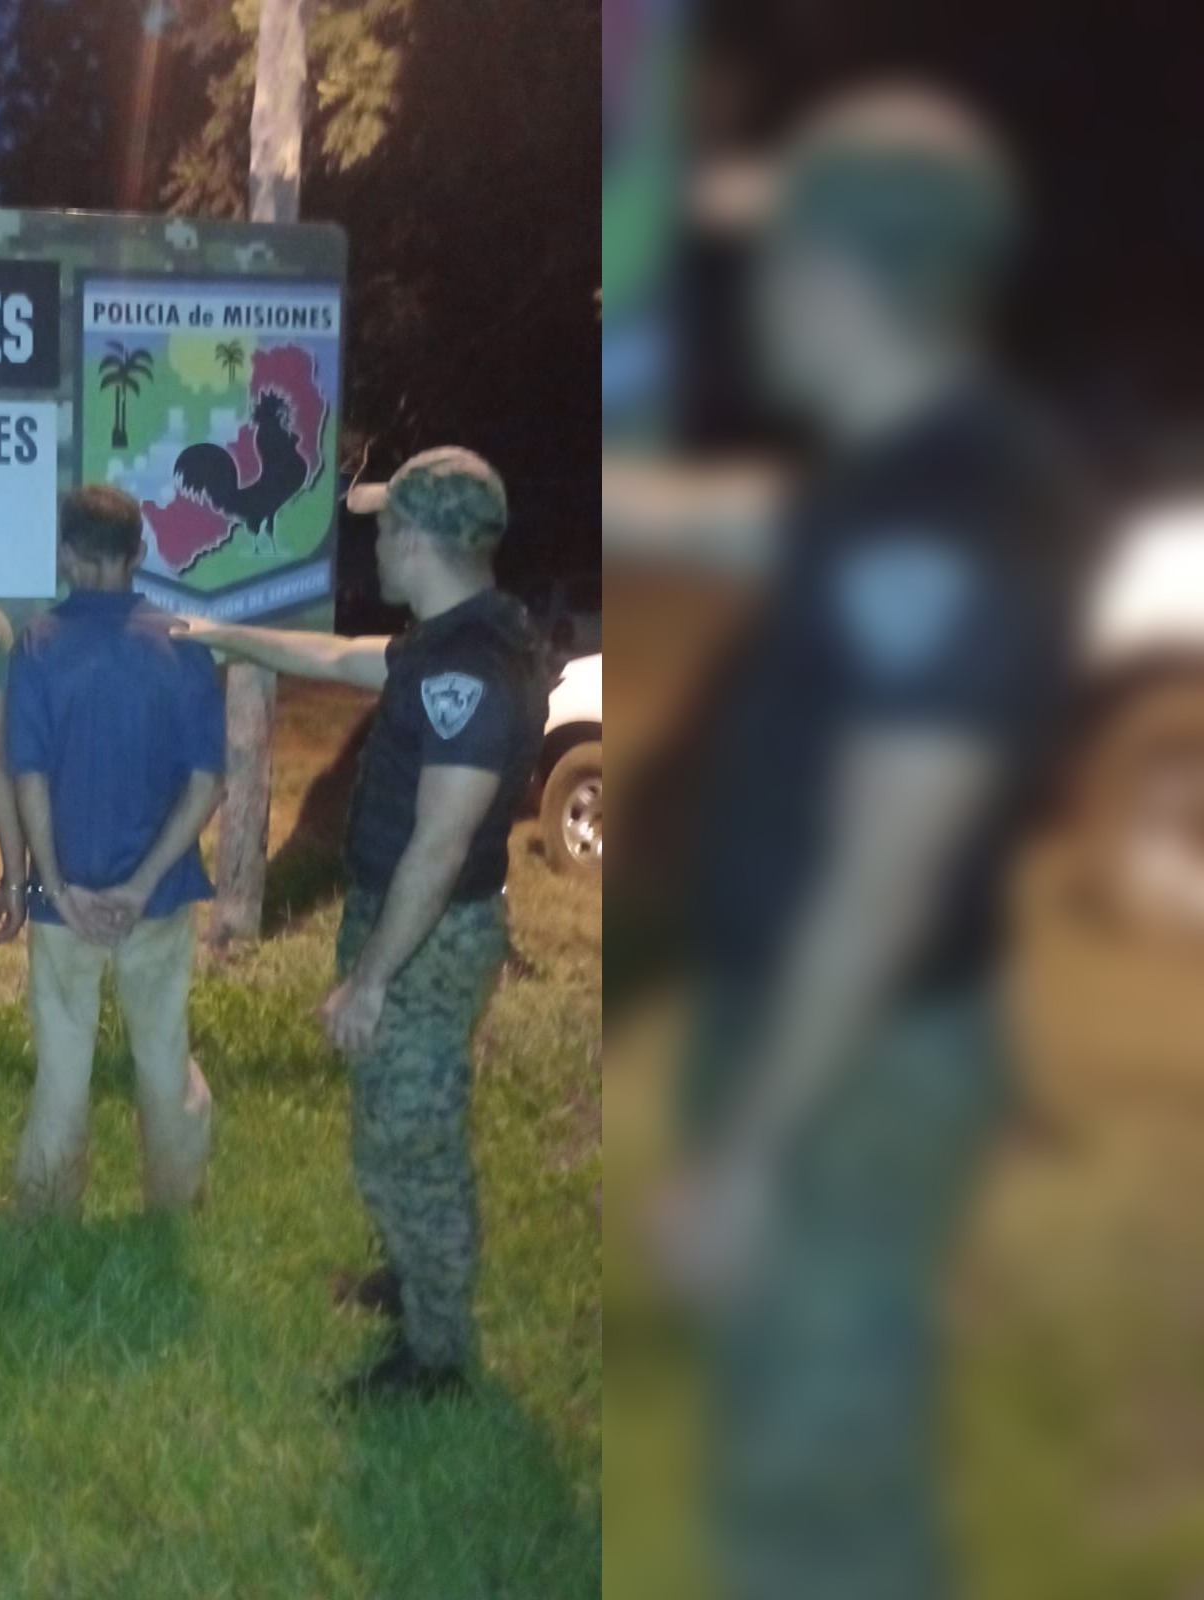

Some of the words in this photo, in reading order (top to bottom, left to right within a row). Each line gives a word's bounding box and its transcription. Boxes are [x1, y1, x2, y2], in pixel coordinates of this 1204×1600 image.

[93, 302, 180, 326] POLICIA
[189, 304, 214, 327] de
[223, 305, 333, 331] MISIONES
